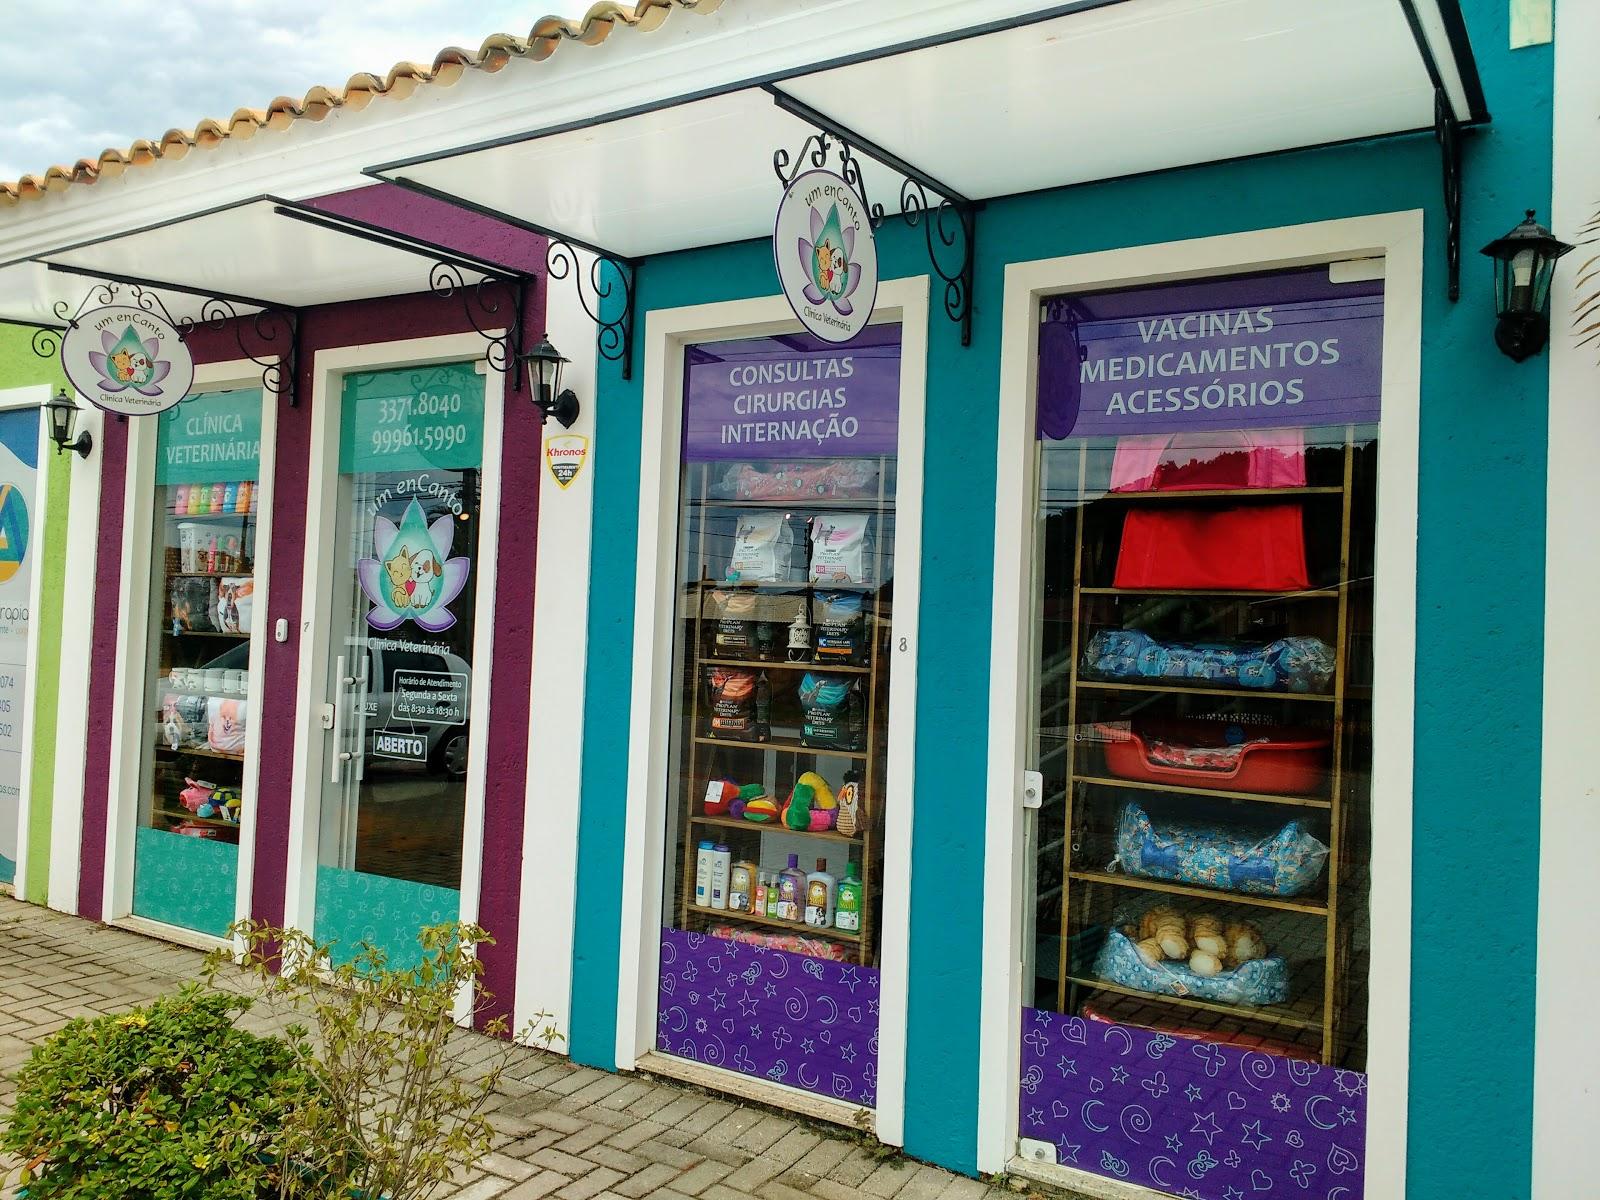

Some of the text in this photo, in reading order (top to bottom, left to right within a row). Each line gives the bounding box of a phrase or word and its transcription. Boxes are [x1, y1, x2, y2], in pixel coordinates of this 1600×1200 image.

[805, 184, 860, 231] um enCanto
[94, 313, 165, 340] um enCanto
[1137, 306, 1275, 343] VACINAS
[729, 356, 854, 387] CONSULTAS
[1079, 338, 1341, 384] MEDICAMENTOS
[378, 391, 461, 424] 3371.8040
[733, 387, 847, 415] CIRURGIAS
[1105, 379, 1305, 416] ACESSÓRIOS
[186, 411, 243, 436] CLÍNICA
[720, 412, 859, 446] INTERNAÇÃO
[166, 437, 261, 465] VETERINÁRIA
[372, 424, 467, 455] 99961.5990
[546, 447, 586, 457] Khronos
[557, 469, 573, 477] 24h
[367, 473, 463, 517] um enCanto
[399, 639, 451, 656] Veterinária
[899, 637, 908, 652] 8
[401, 688, 432, 701] Segunda
[437, 692, 458, 702] Sexta
[419, 677, 427, 687] de
[427, 678, 463, 689] Atendimento
[398, 702, 411, 712] das
[411, 704, 426, 715] 8:30
[435, 705, 454, 717] 18:30
[454, 706, 460, 716] h
[376, 734, 424, 756] ABERTO
